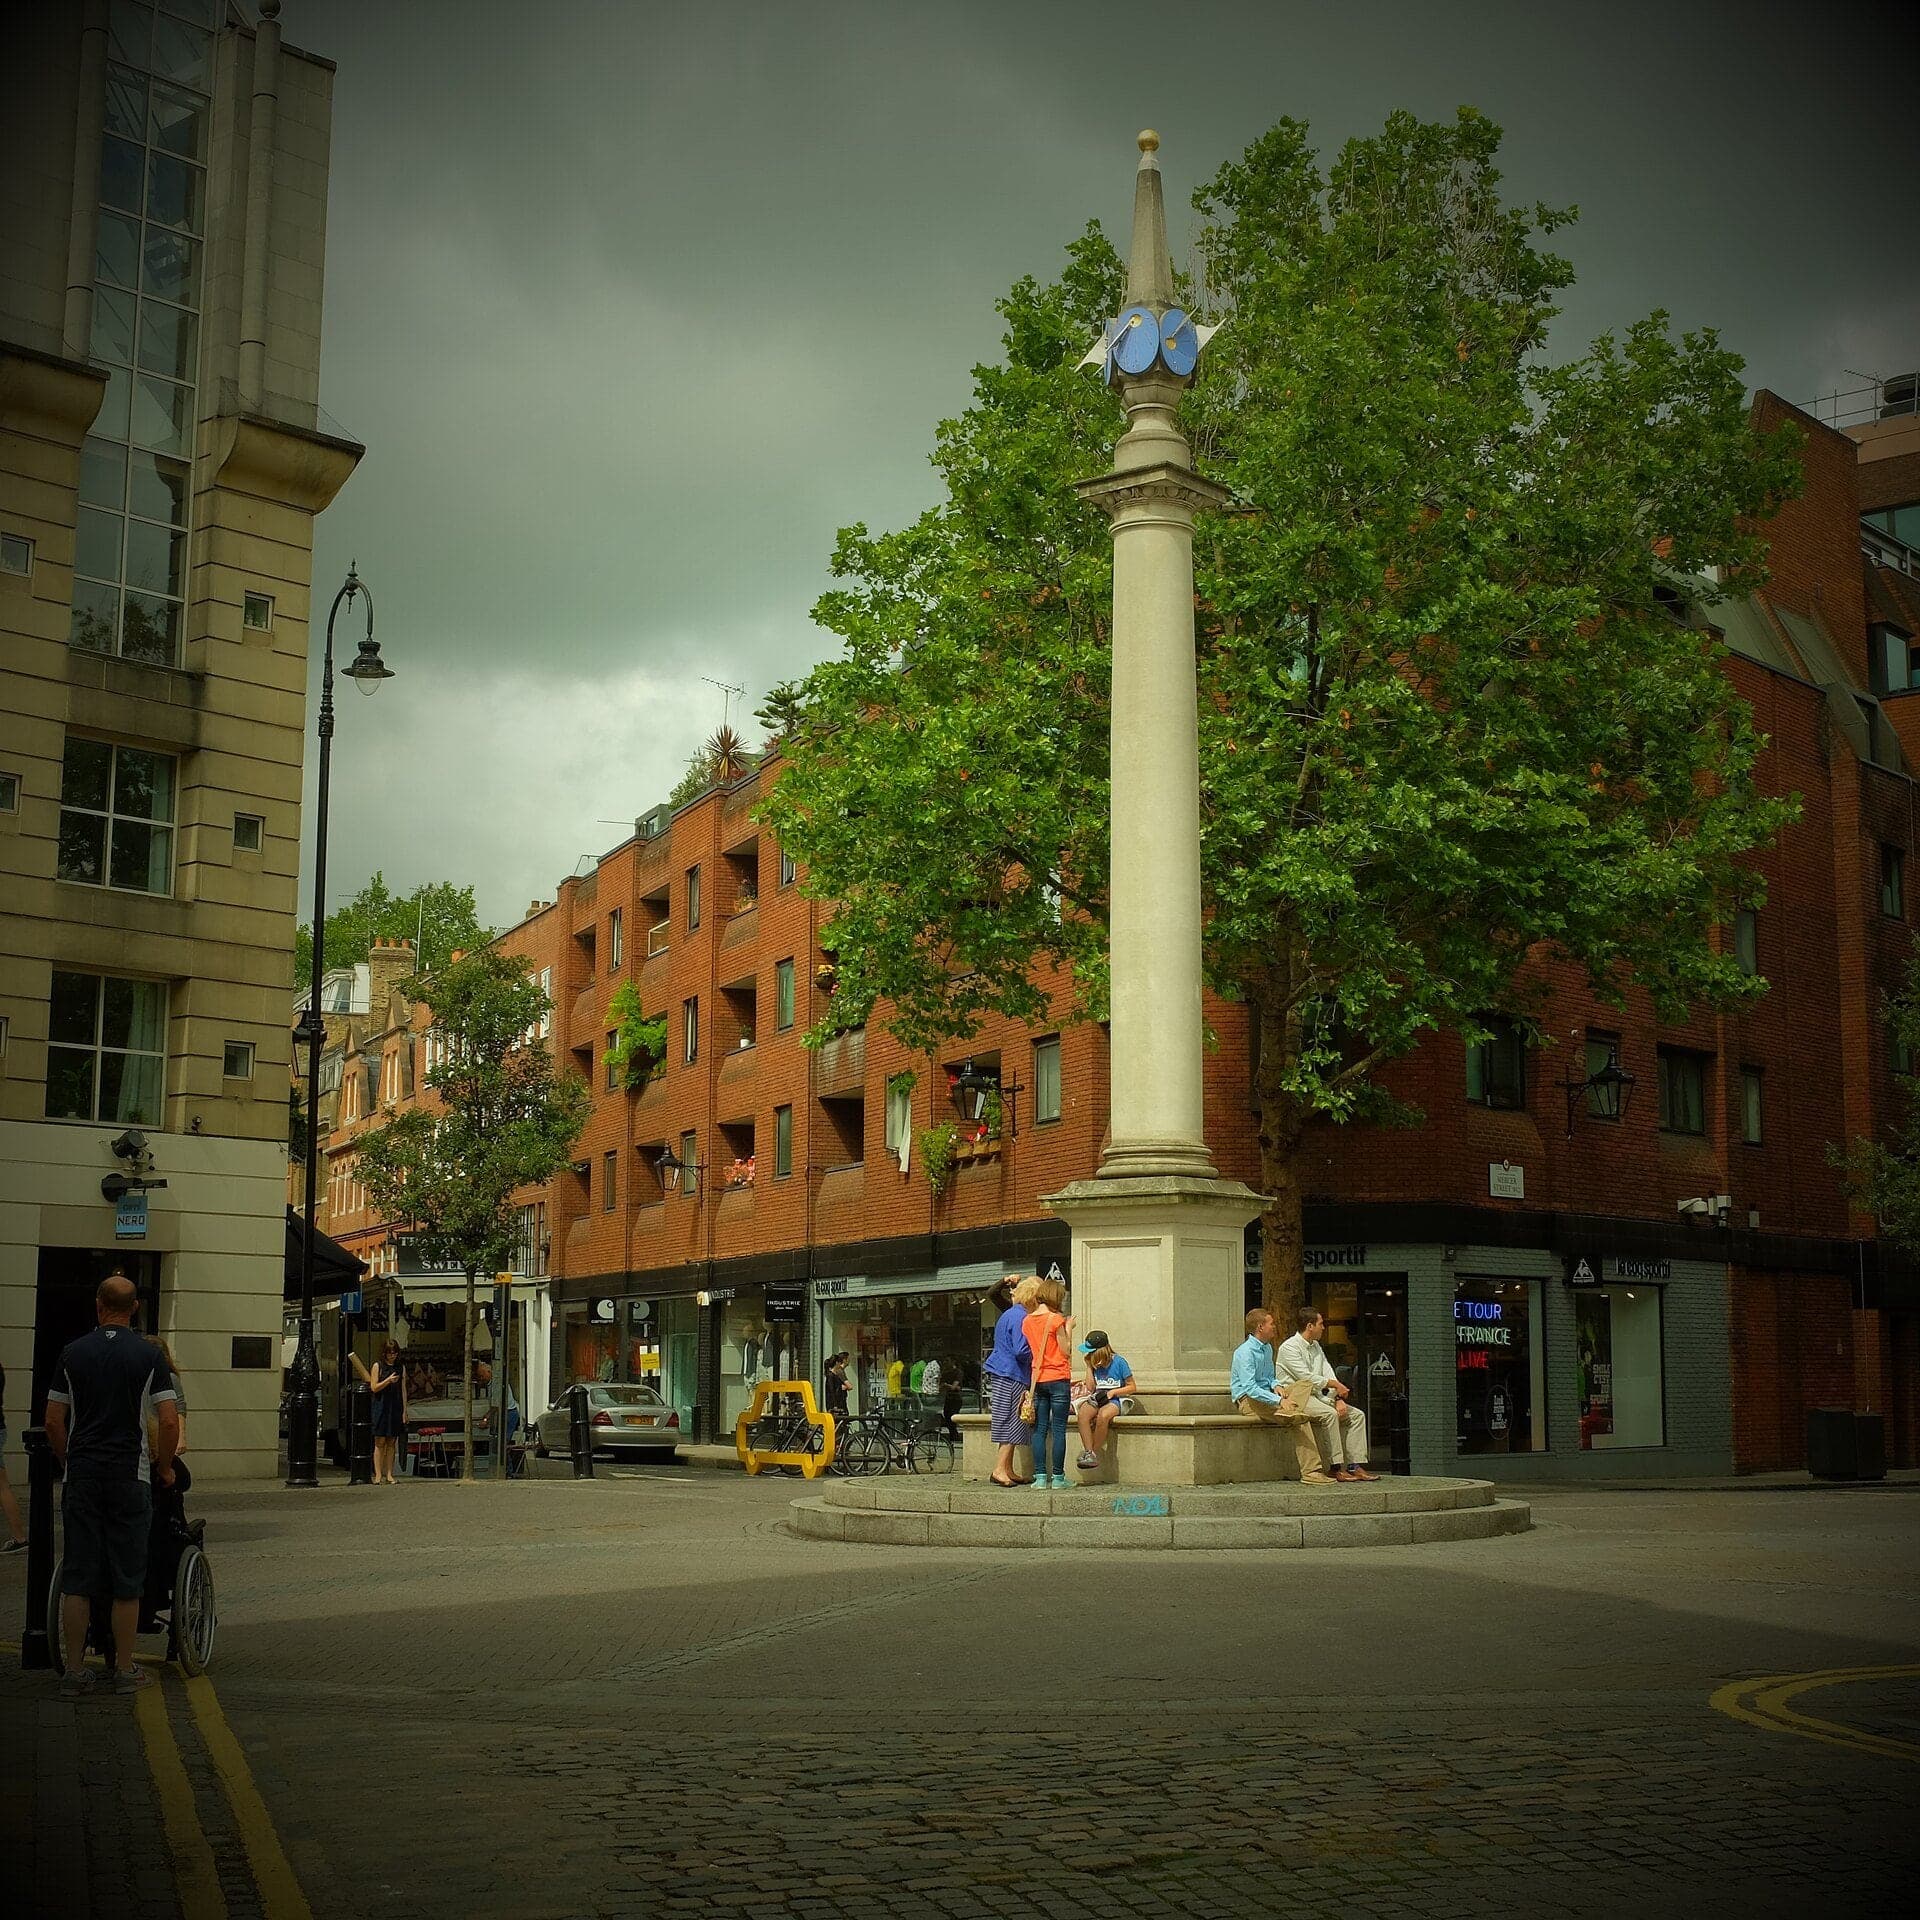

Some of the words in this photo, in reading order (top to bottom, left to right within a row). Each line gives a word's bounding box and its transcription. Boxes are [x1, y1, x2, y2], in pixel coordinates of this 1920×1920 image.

[1493, 1183, 1512, 1193] STREET
[117, 1215, 145, 1226] NERO
[1303, 1246, 1367, 1269] sportif
[1467, 1302, 1502, 1319] TOUR
[1457, 1326, 1512, 1346] FRANCE
